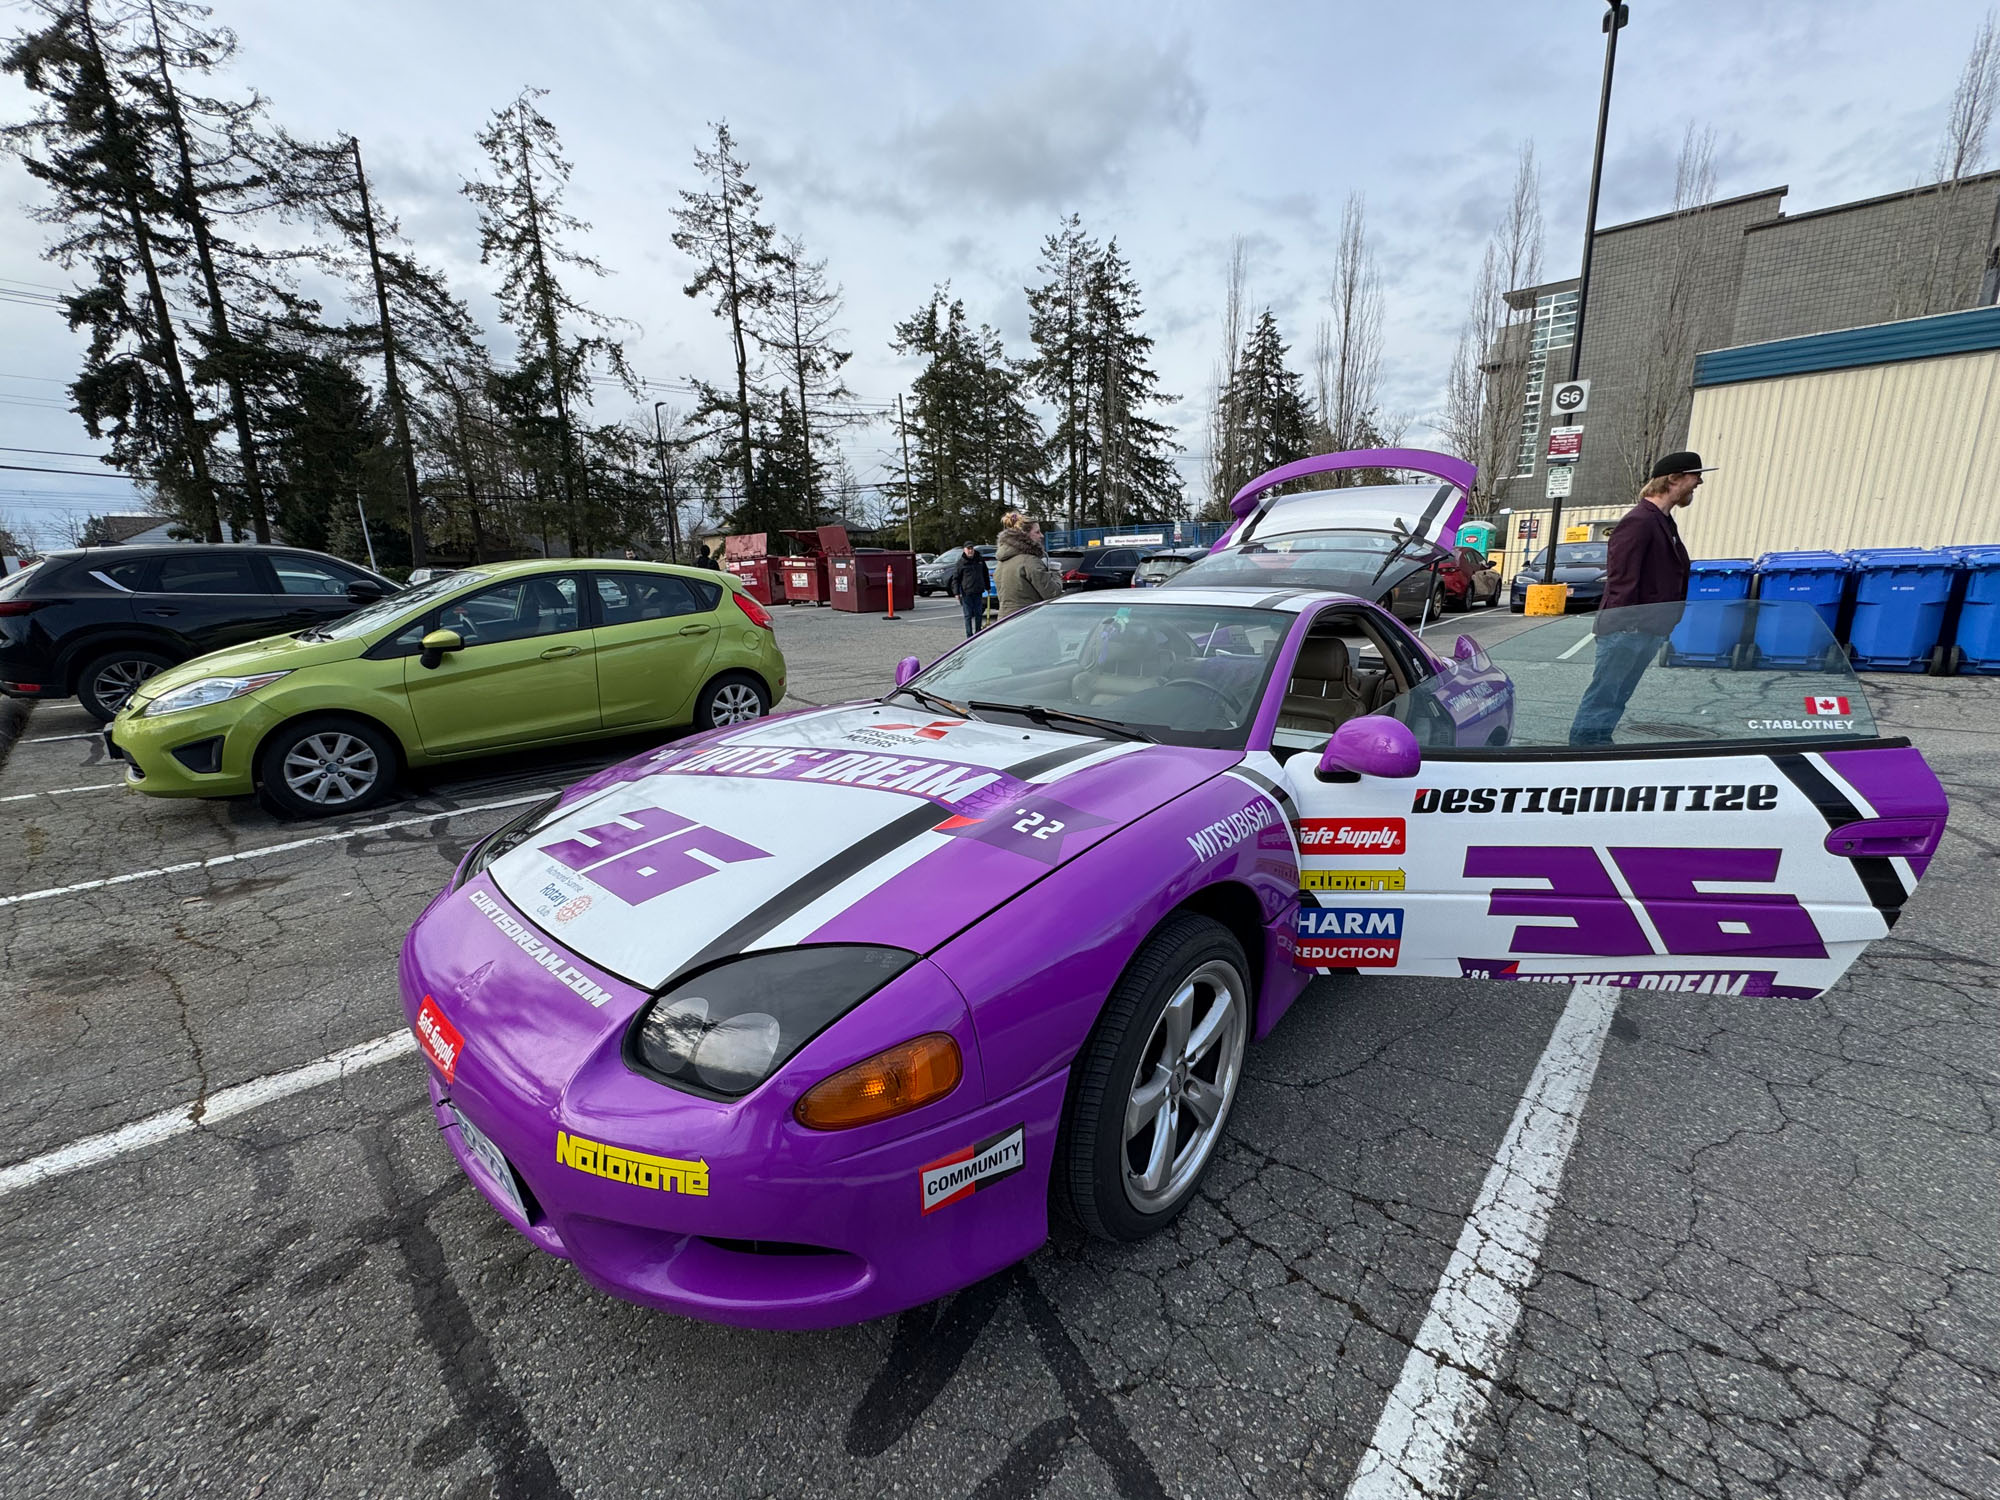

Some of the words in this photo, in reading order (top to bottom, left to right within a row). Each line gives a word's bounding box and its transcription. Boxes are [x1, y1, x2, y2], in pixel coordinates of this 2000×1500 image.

[1559, 390, 1580, 405] S6
[850, 728, 926, 745] MITSUBISHI
[1747, 719, 1855, 731] C.TABLOTNEY
[841, 734, 898, 748] MOTORS
[667, 746, 832, 774] URTIS'
[798, 753, 1003, 804] DREAM
[1012, 808, 1065, 840] '22
[1186, 800, 1272, 863] MITSUBISHI
[1334, 826, 1398, 848] Supply
[537, 806, 775, 907] 36
[1299, 867, 1406, 891] aloxone
[540, 882, 570, 908] Rotary
[1463, 845, 1828, 958] 36
[1298, 912, 1396, 935] HARM
[468, 889, 613, 1008] CURTISDREAM.COM
[1294, 946, 1394, 959] REDUCTION
[417, 1007, 435, 1037] Safe
[429, 1025, 455, 1072] Supply
[556, 1130, 711, 1197] Naloxone
[927, 1141, 1021, 1196] COMMUNITY
